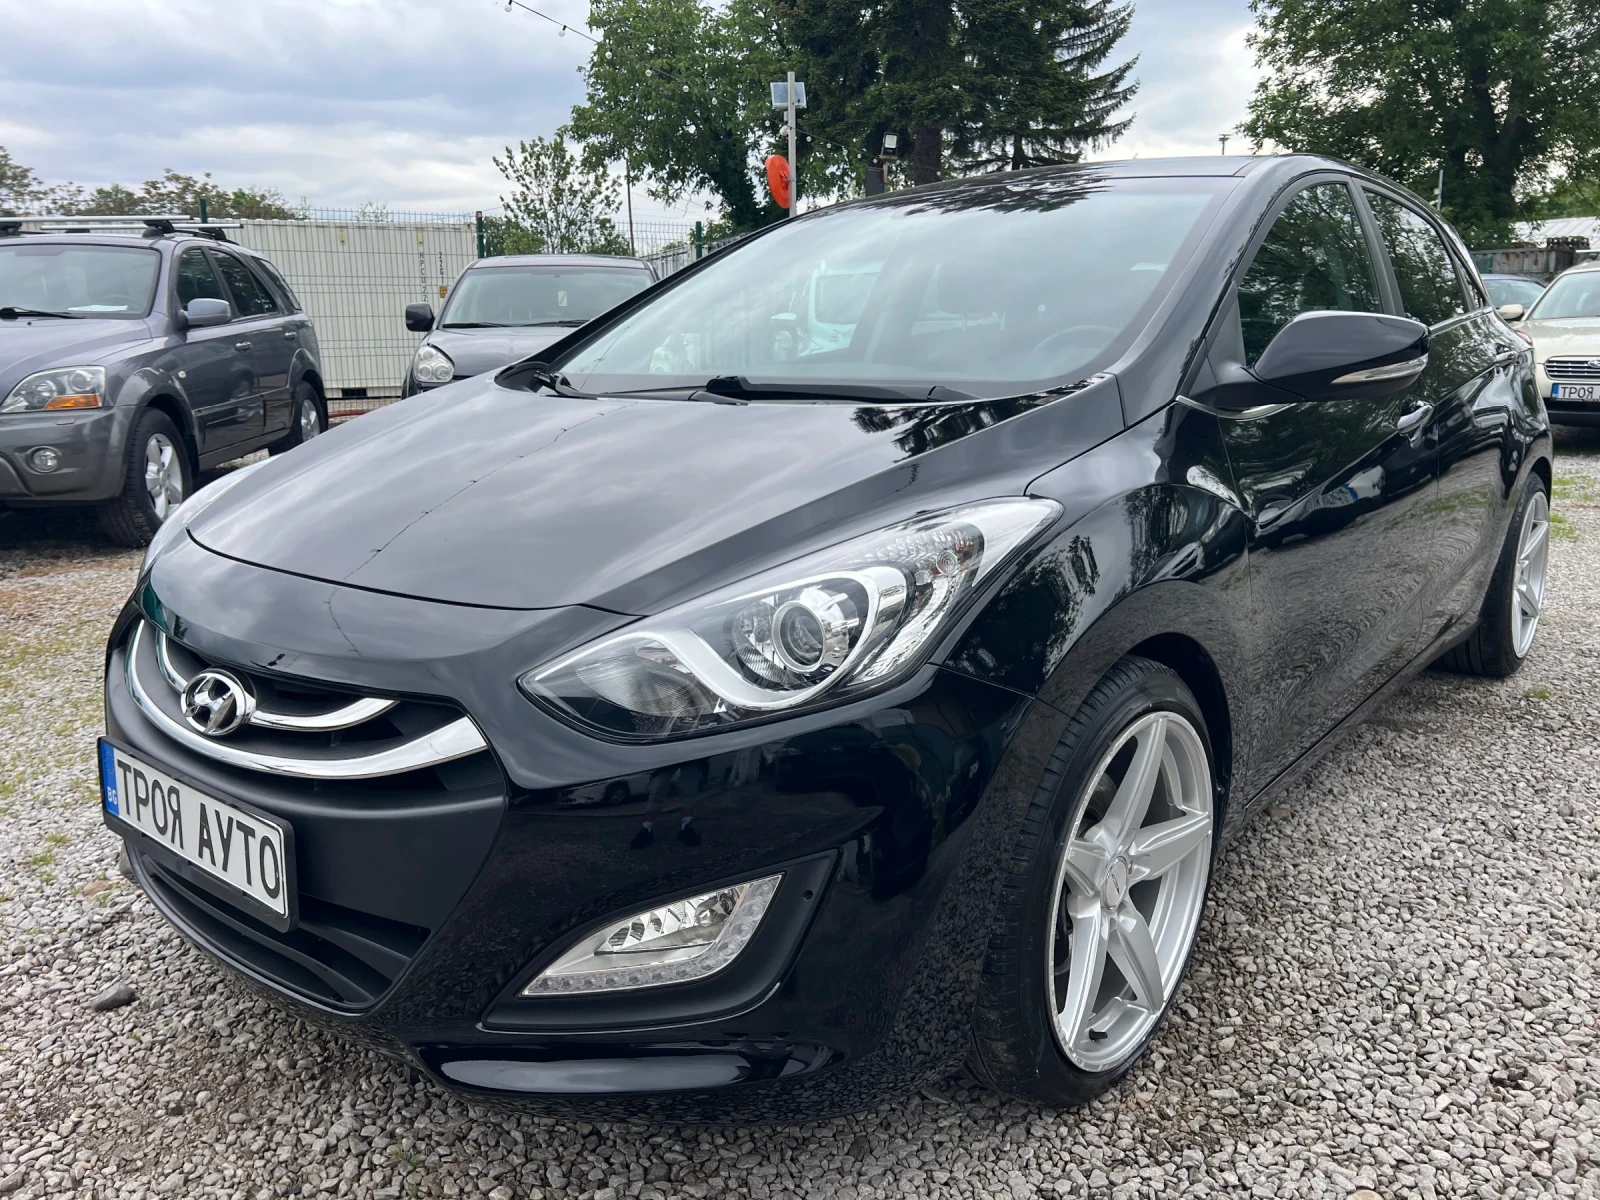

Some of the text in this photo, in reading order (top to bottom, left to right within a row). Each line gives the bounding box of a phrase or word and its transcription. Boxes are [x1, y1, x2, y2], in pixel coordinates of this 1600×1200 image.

[1561, 386, 1594, 399] ТРОЯ
[107, 785, 118, 805] BG
[117, 758, 280, 899] ТРОЯ АУТО
